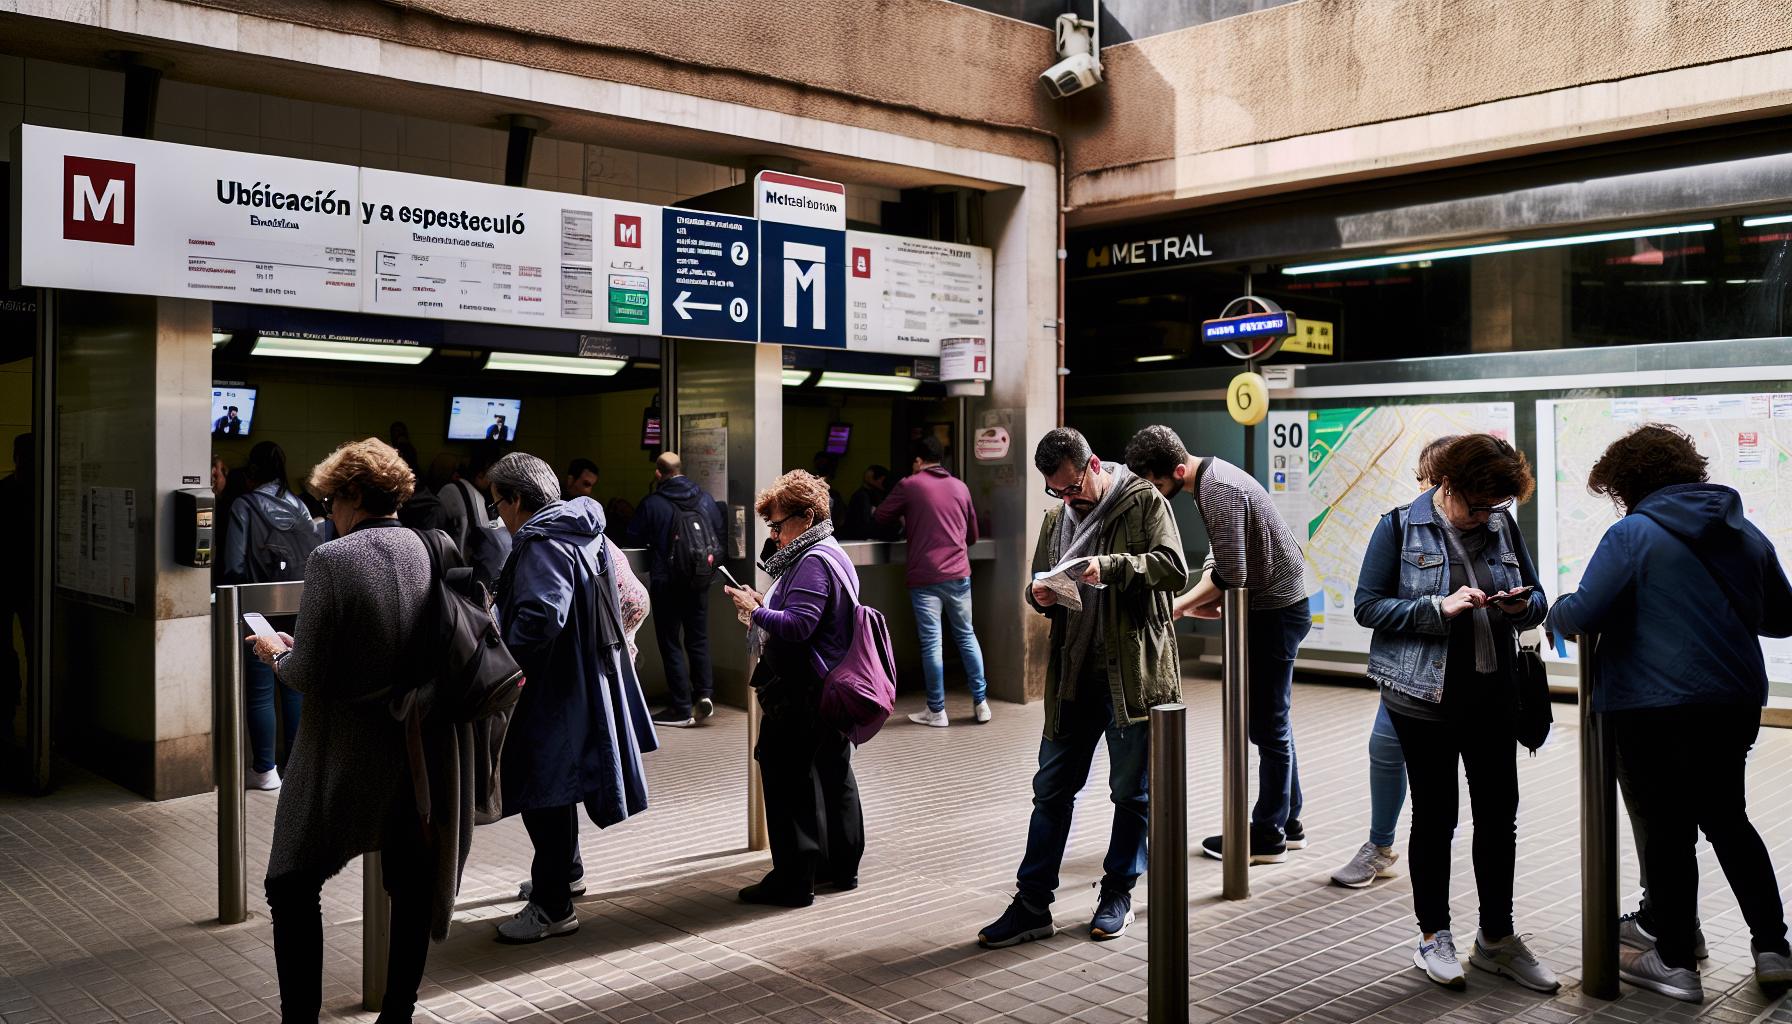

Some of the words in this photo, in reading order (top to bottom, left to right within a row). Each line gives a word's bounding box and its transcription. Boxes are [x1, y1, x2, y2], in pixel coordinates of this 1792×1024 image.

[73, 174, 125, 225] M
[361, 201, 376, 225] y
[380, 204, 394, 222] a
[1112, 233, 1213, 265] METRAL
[1236, 383, 1252, 410] 6
